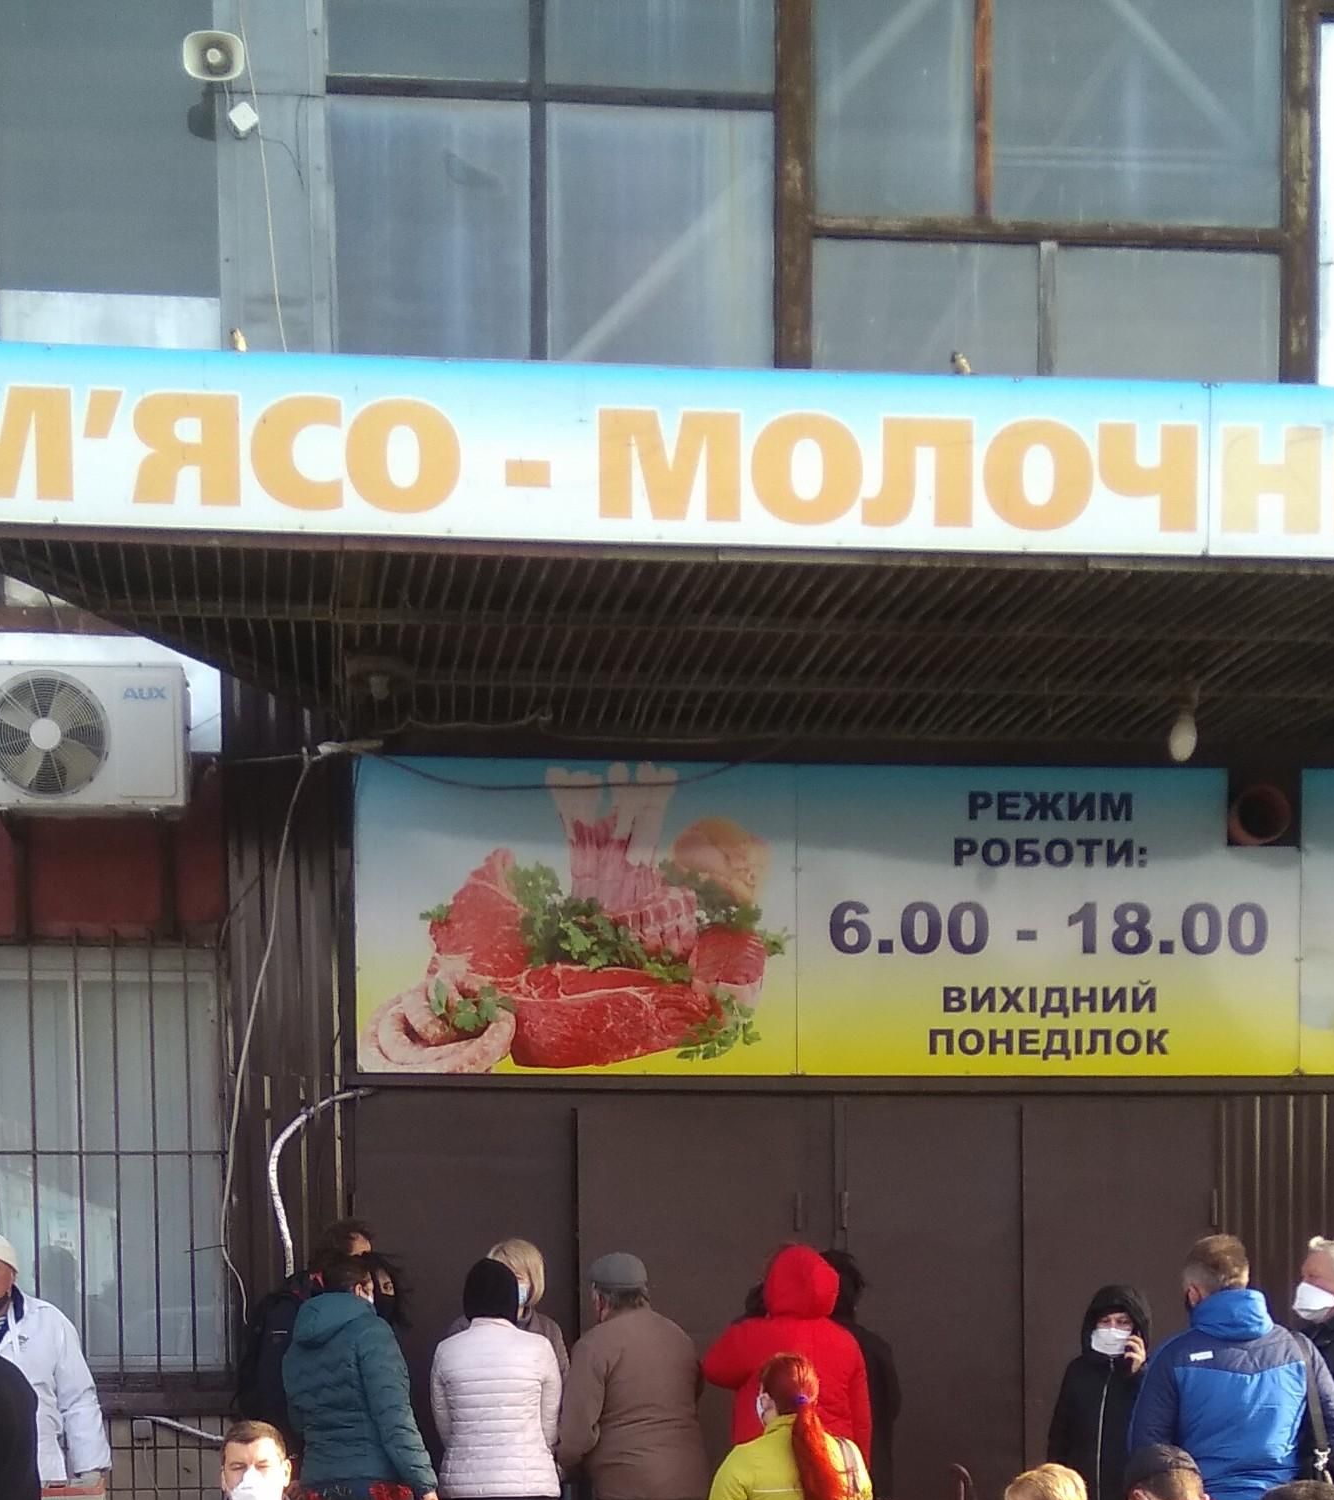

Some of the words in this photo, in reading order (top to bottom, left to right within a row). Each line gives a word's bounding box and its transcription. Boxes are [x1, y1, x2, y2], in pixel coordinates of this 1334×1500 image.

[122, 686, 167, 700] AUX
[967, 791, 1133, 822] РЕЖИМ
[953, 837, 1149, 868] РОБОТИ:
[828, 900, 990, 956] 6.00
[1067, 900, 1269, 956] 18.00
[942, 979, 1158, 1019] ВИХІДНИЙ
[928, 1027, 1170, 1061] ПОНЕДІЛОК
